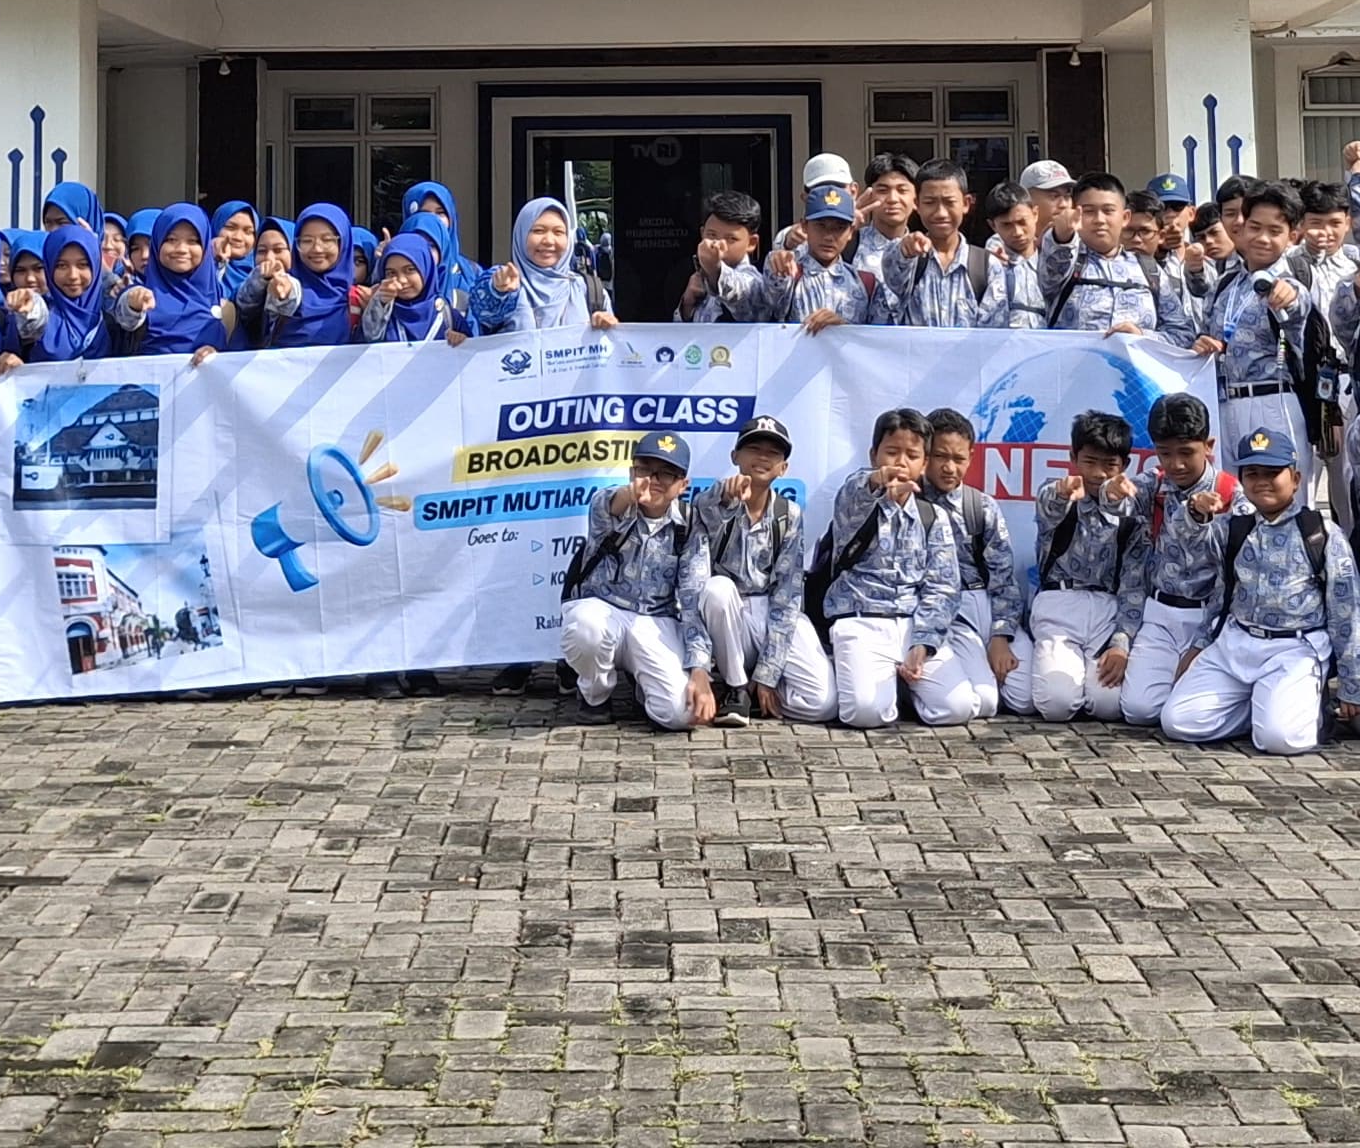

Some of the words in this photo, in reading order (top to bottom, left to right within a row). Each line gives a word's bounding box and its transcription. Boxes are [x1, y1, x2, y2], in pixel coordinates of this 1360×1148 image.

[545, 346, 585, 359] SMPIT
[508, 397, 625, 432] OUTING
[632, 397, 738, 425] CLASS
[422, 495, 497, 522] SMPIT
[468, 528, 496, 546] Goes
[501, 528, 520, 541] to:
